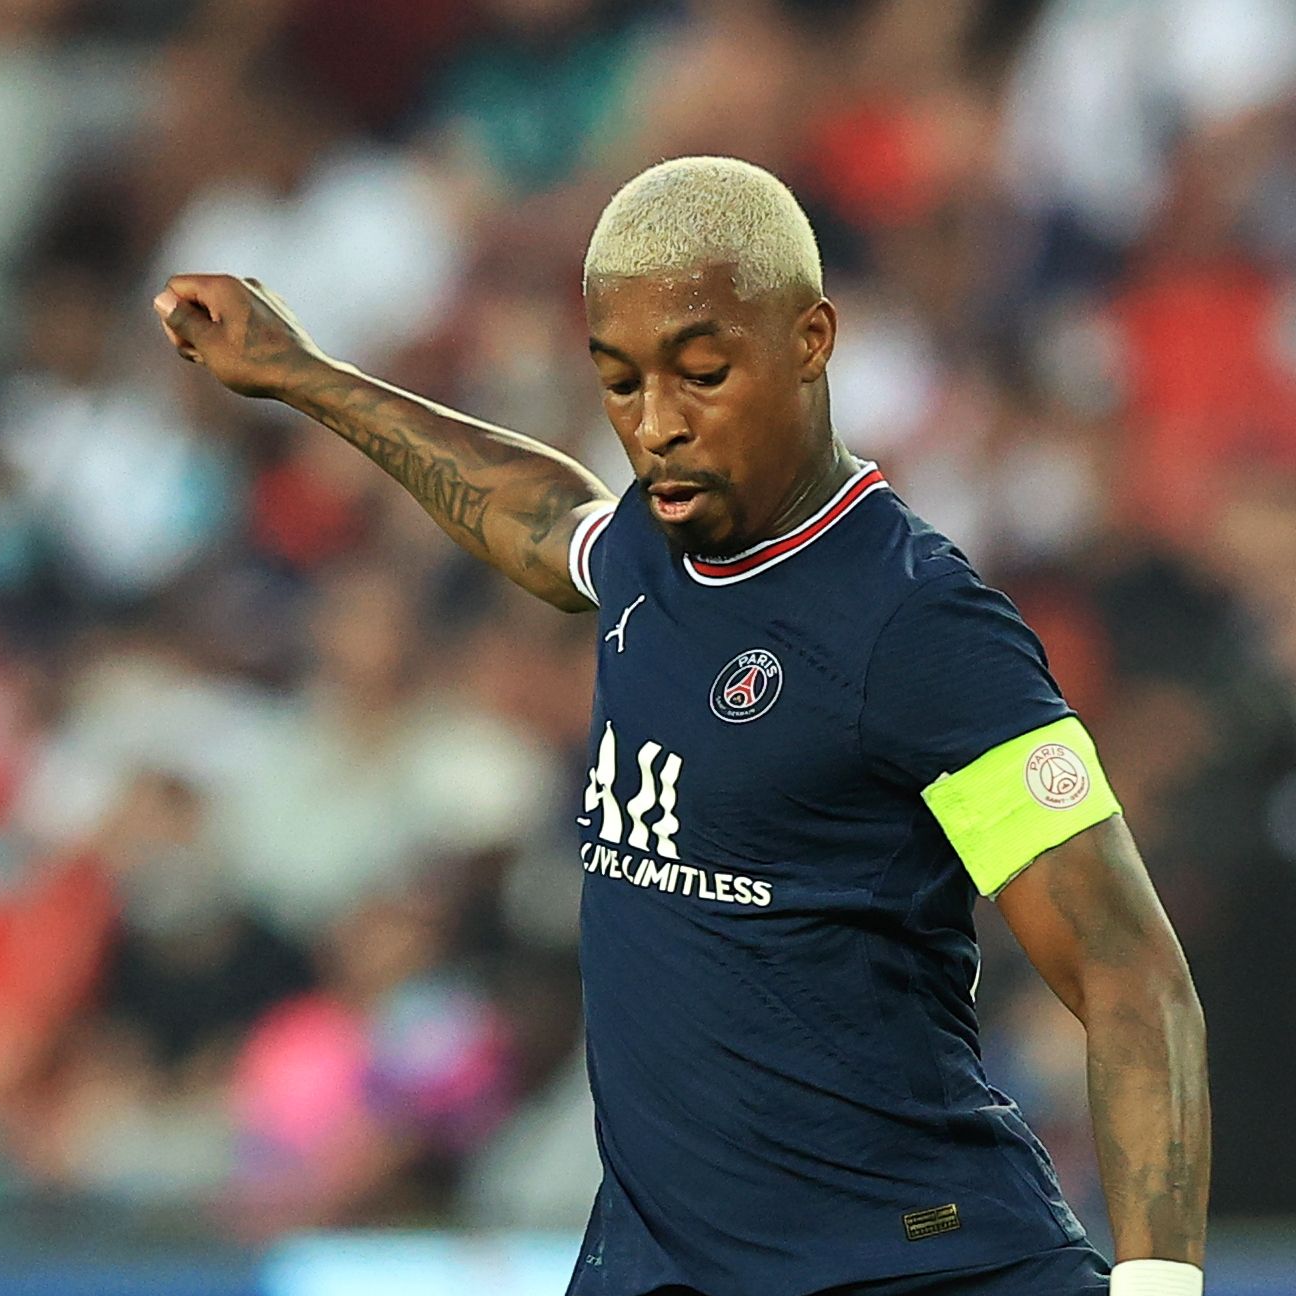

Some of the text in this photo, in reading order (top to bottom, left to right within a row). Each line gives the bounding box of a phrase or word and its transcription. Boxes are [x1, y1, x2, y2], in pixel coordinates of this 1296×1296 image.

[738, 653, 778, 678] PARIS
[1029, 748, 1065, 771] PARIS
[622, 855, 773, 907] LIMITLESS
